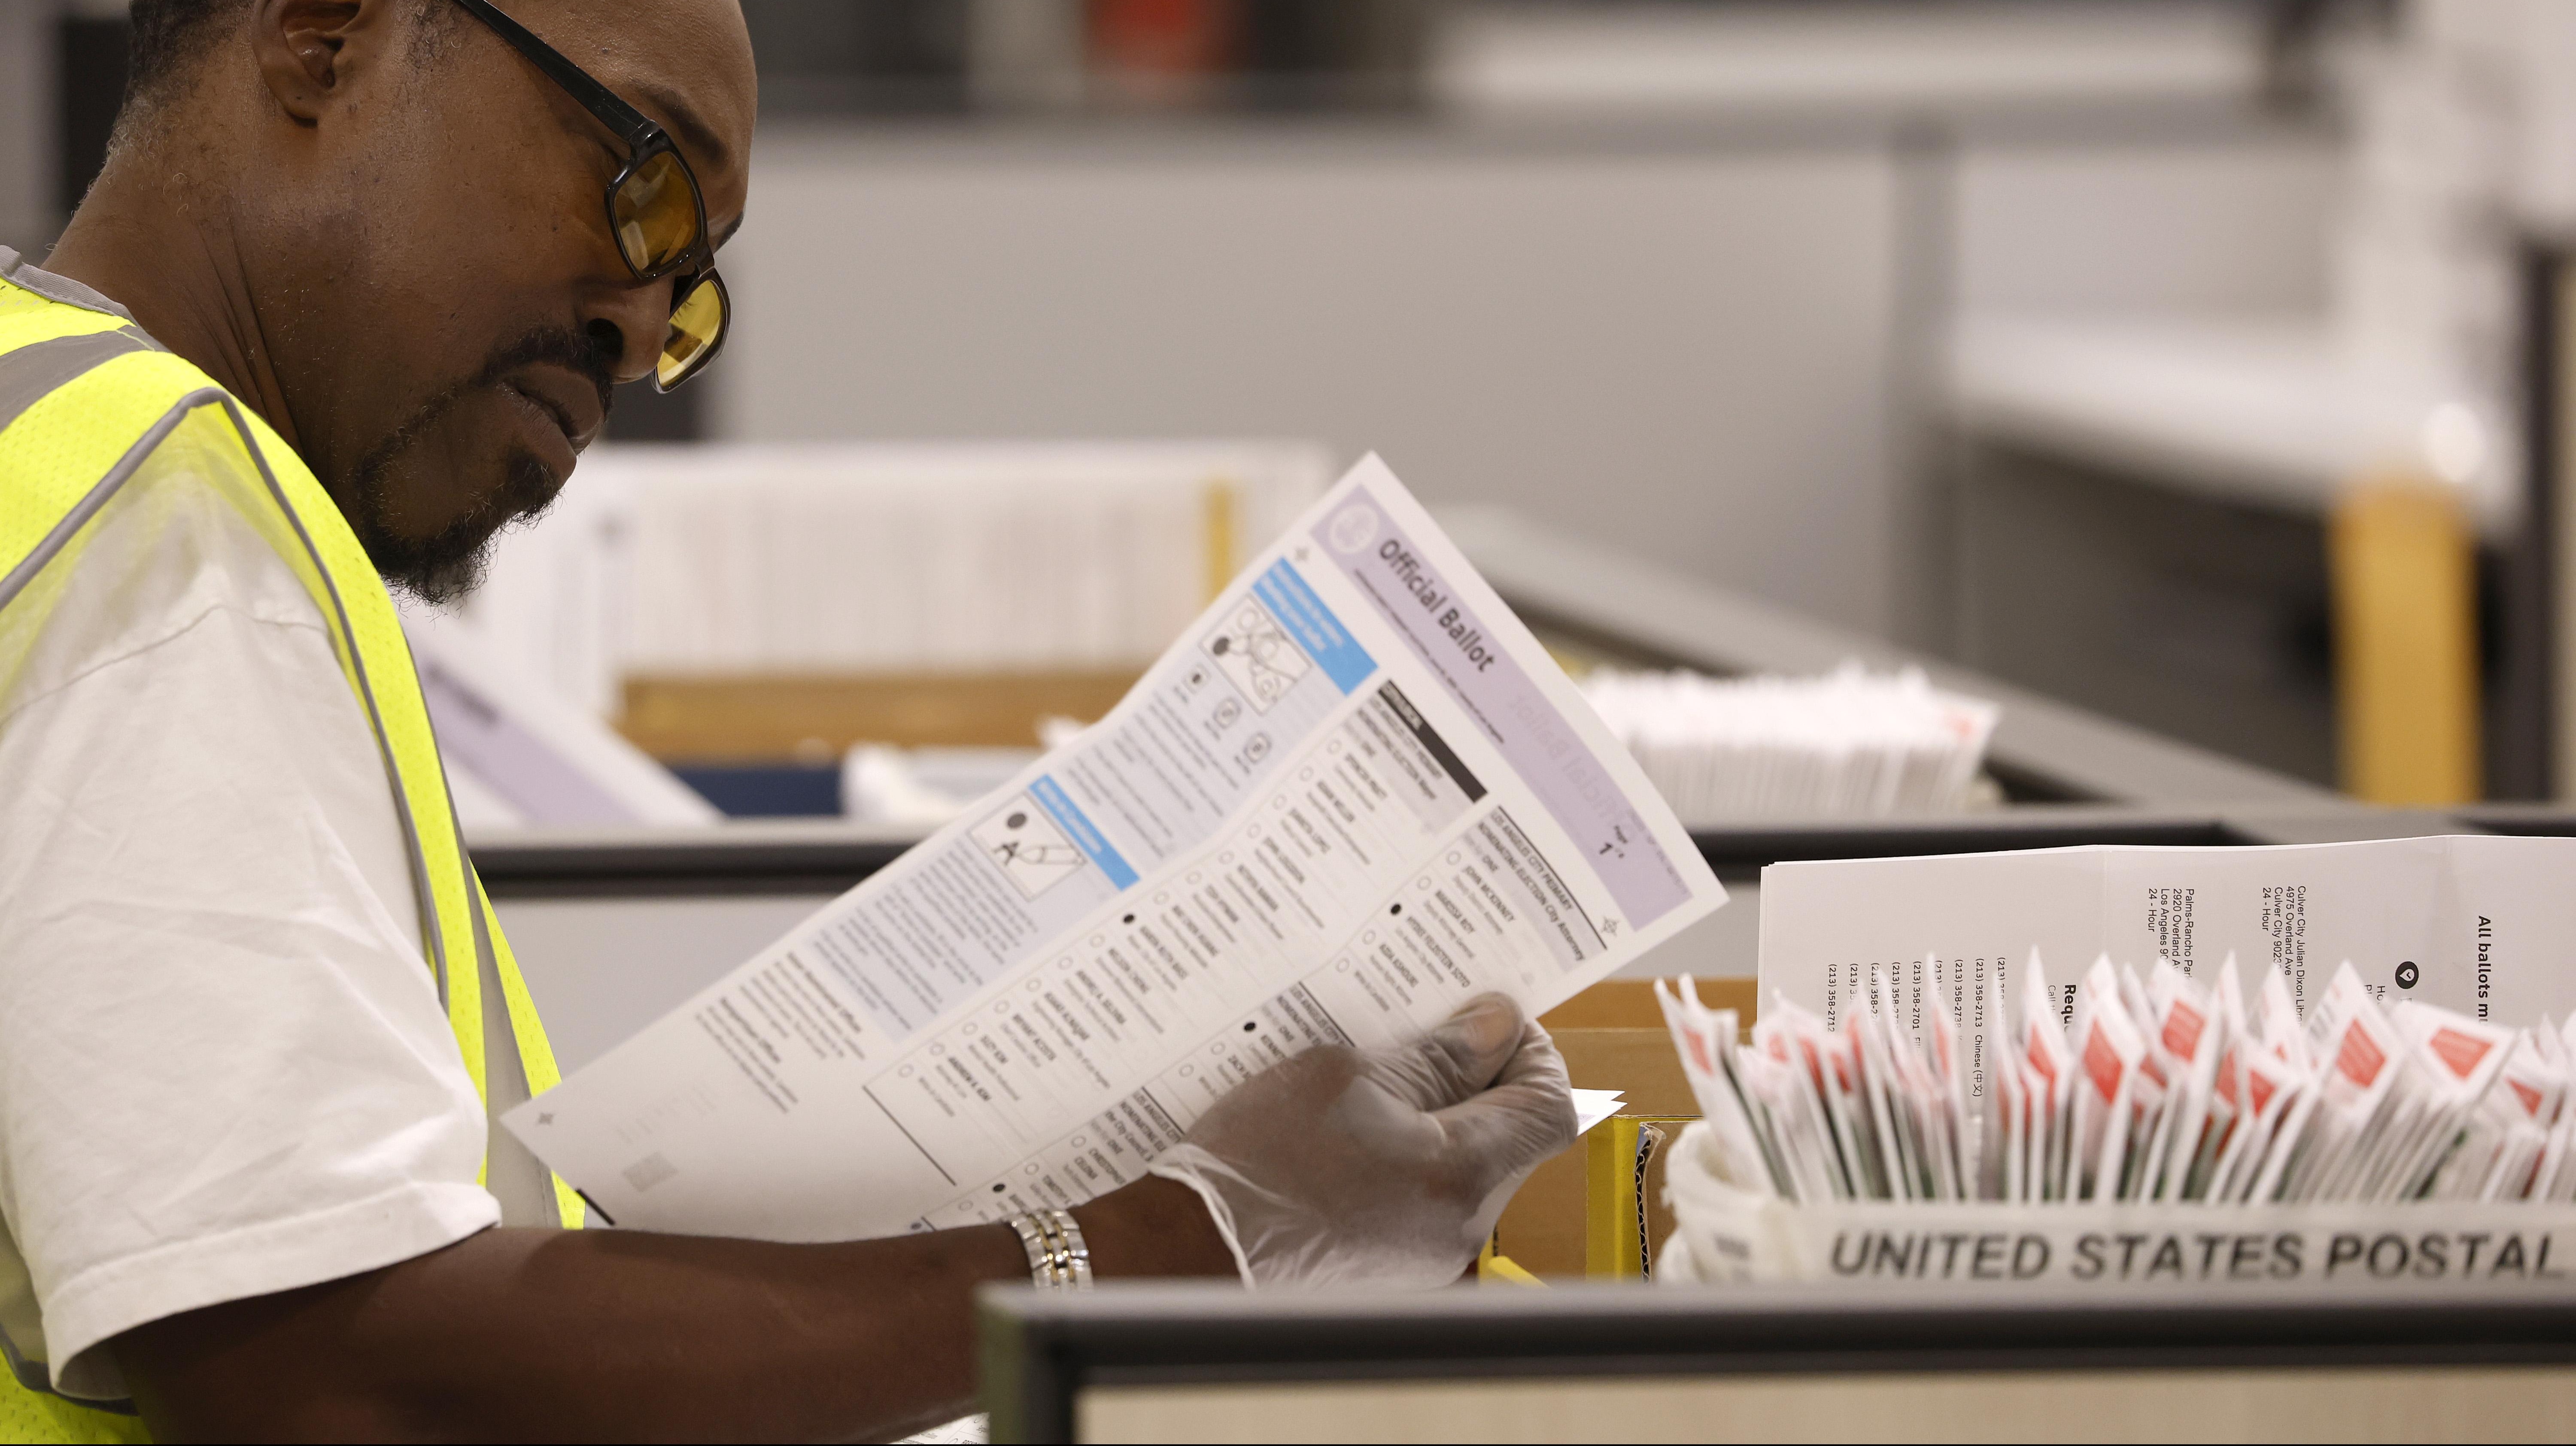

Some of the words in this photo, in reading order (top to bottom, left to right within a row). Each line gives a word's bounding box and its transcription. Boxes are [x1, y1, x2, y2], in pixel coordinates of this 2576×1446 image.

[1379, 539, 1446, 612] Official
[1438, 608, 1494, 671] Ballot
[1599, 843, 1613, 855] 1
[2148, 888, 2157, 900] 24
[2160, 888, 2170, 905] Los
[2172, 888, 2182, 912] 2920
[2262, 887, 2271, 899] 24
[2274, 886, 2283, 917] Culver
[2285, 886, 2294, 910] 4975
[2297, 885, 2306, 916] Culver
[2148, 909, 2157, 932] Hour
[2158, 907, 2169, 946] Angeles
[2184, 888, 2194, 957] Palms-Rancho
[2262, 908, 2271, 931] Hour
[2271, 919, 2282, 938] City
[2294, 918, 2306, 937] City
[2478, 915, 2491, 938] All
[2172, 914, 2181, 956] Overland
[2285, 912, 2294, 955] Overland
[2296, 939, 2306, 967] Julian
[1828, 964, 1837, 987] (213)
[1849, 964, 1858, 986] (213)
[1870, 963, 1879, 985] (213)
[1891, 962, 1900, 985] (213)
[1912, 961, 1921, 984] (213)
[1934, 960, 1942, 983] (213)
[1954, 959, 1963, 982] (213)
[1975, 958, 1984, 982] (213)
[1996, 957, 2005, 980] (213)
[2284, 957, 2293, 976] Ave
[2478, 943, 2491, 998] ballots
[2296, 969, 2305, 997] Dixon
[1827, 990, 1835, 1032] 358-2712
[1912, 987, 1920, 1030] 358-2701
[1975, 985, 1983, 1027] 358-2713
[1974, 1034, 1983, 1067] Chinese
[1972, 1070, 1982, 1097] (中文)
[1831, 1231, 2052, 1280] UNITED
[2071, 1231, 2304, 1281] STATES
[2322, 1231, 2567, 1281] POSTAL
